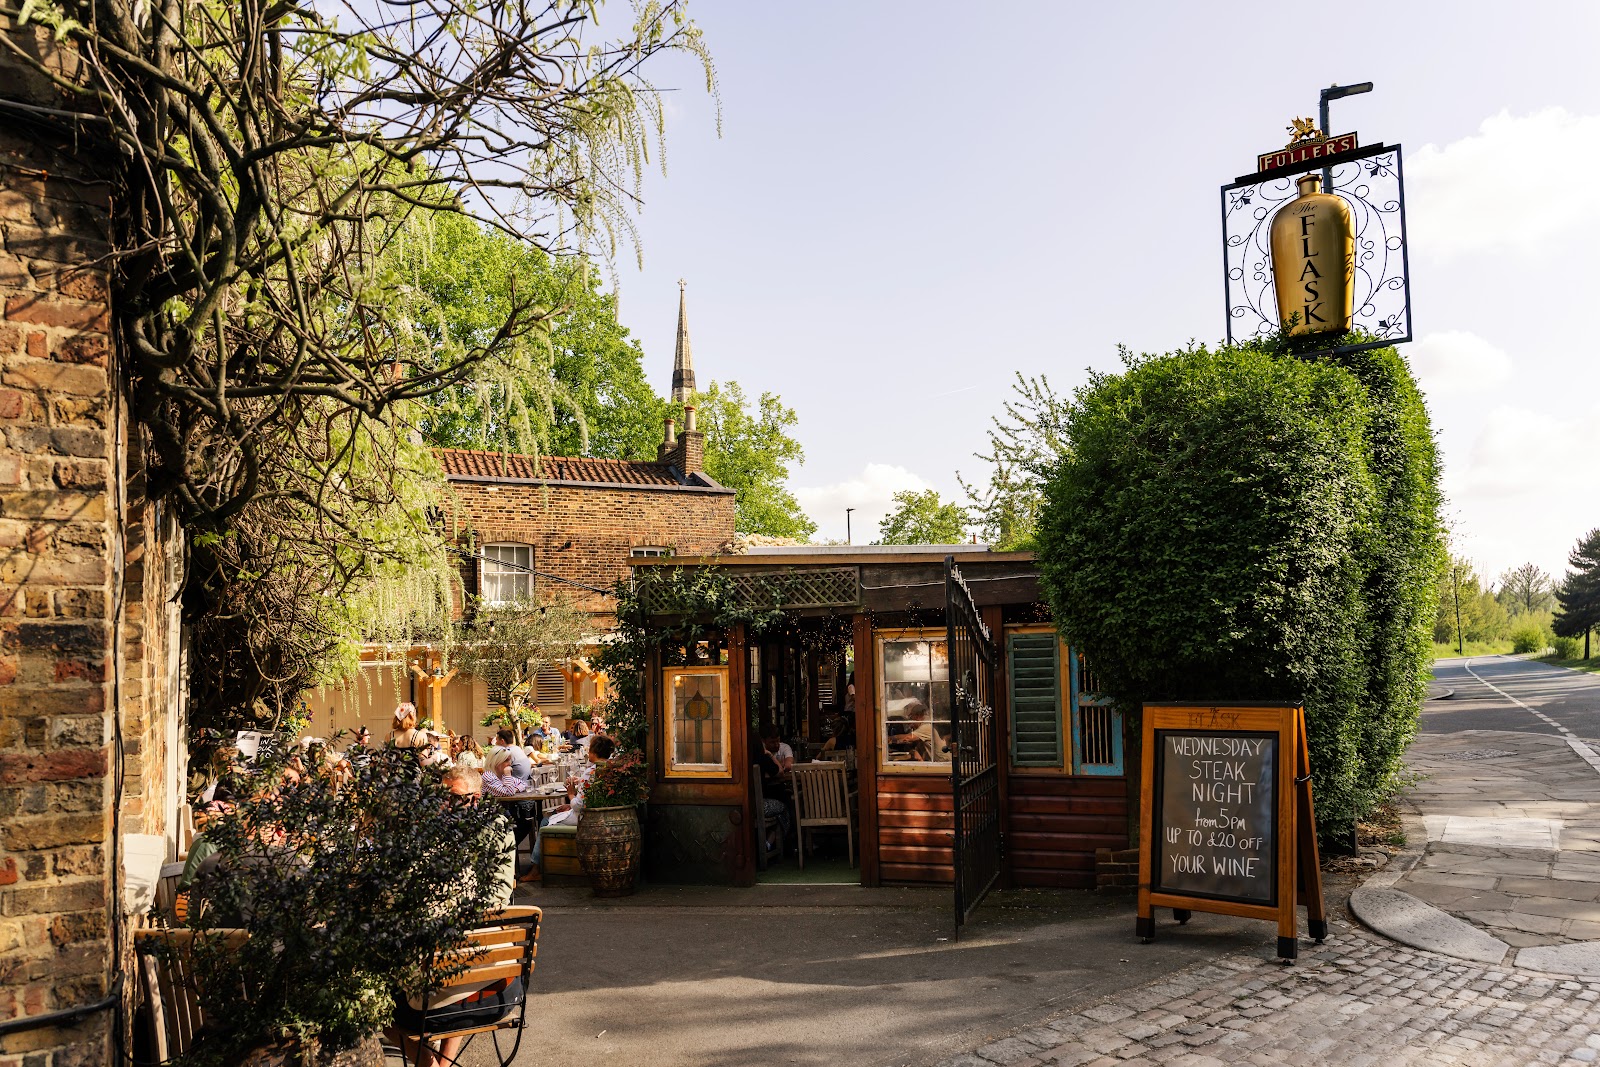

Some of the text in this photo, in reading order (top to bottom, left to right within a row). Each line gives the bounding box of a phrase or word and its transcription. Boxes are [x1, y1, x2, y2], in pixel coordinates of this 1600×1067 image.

[1264, 139, 1350, 170] FULLER'S
[1293, 200, 1318, 215] The
[1297, 214, 1328, 325] FLASK
[1188, 712, 1242, 730] FLASK
[1173, 737, 1264, 757] WEDNESDAY
[1189, 760, 1246, 781] STEAK
[1192, 782, 1256, 804] NIGHT
[1166, 827, 1182, 844] UP
[1186, 829, 1202, 846] TO
[1239, 837, 1263, 850] OFF
[1170, 853, 1260, 878] YOUR WINE
